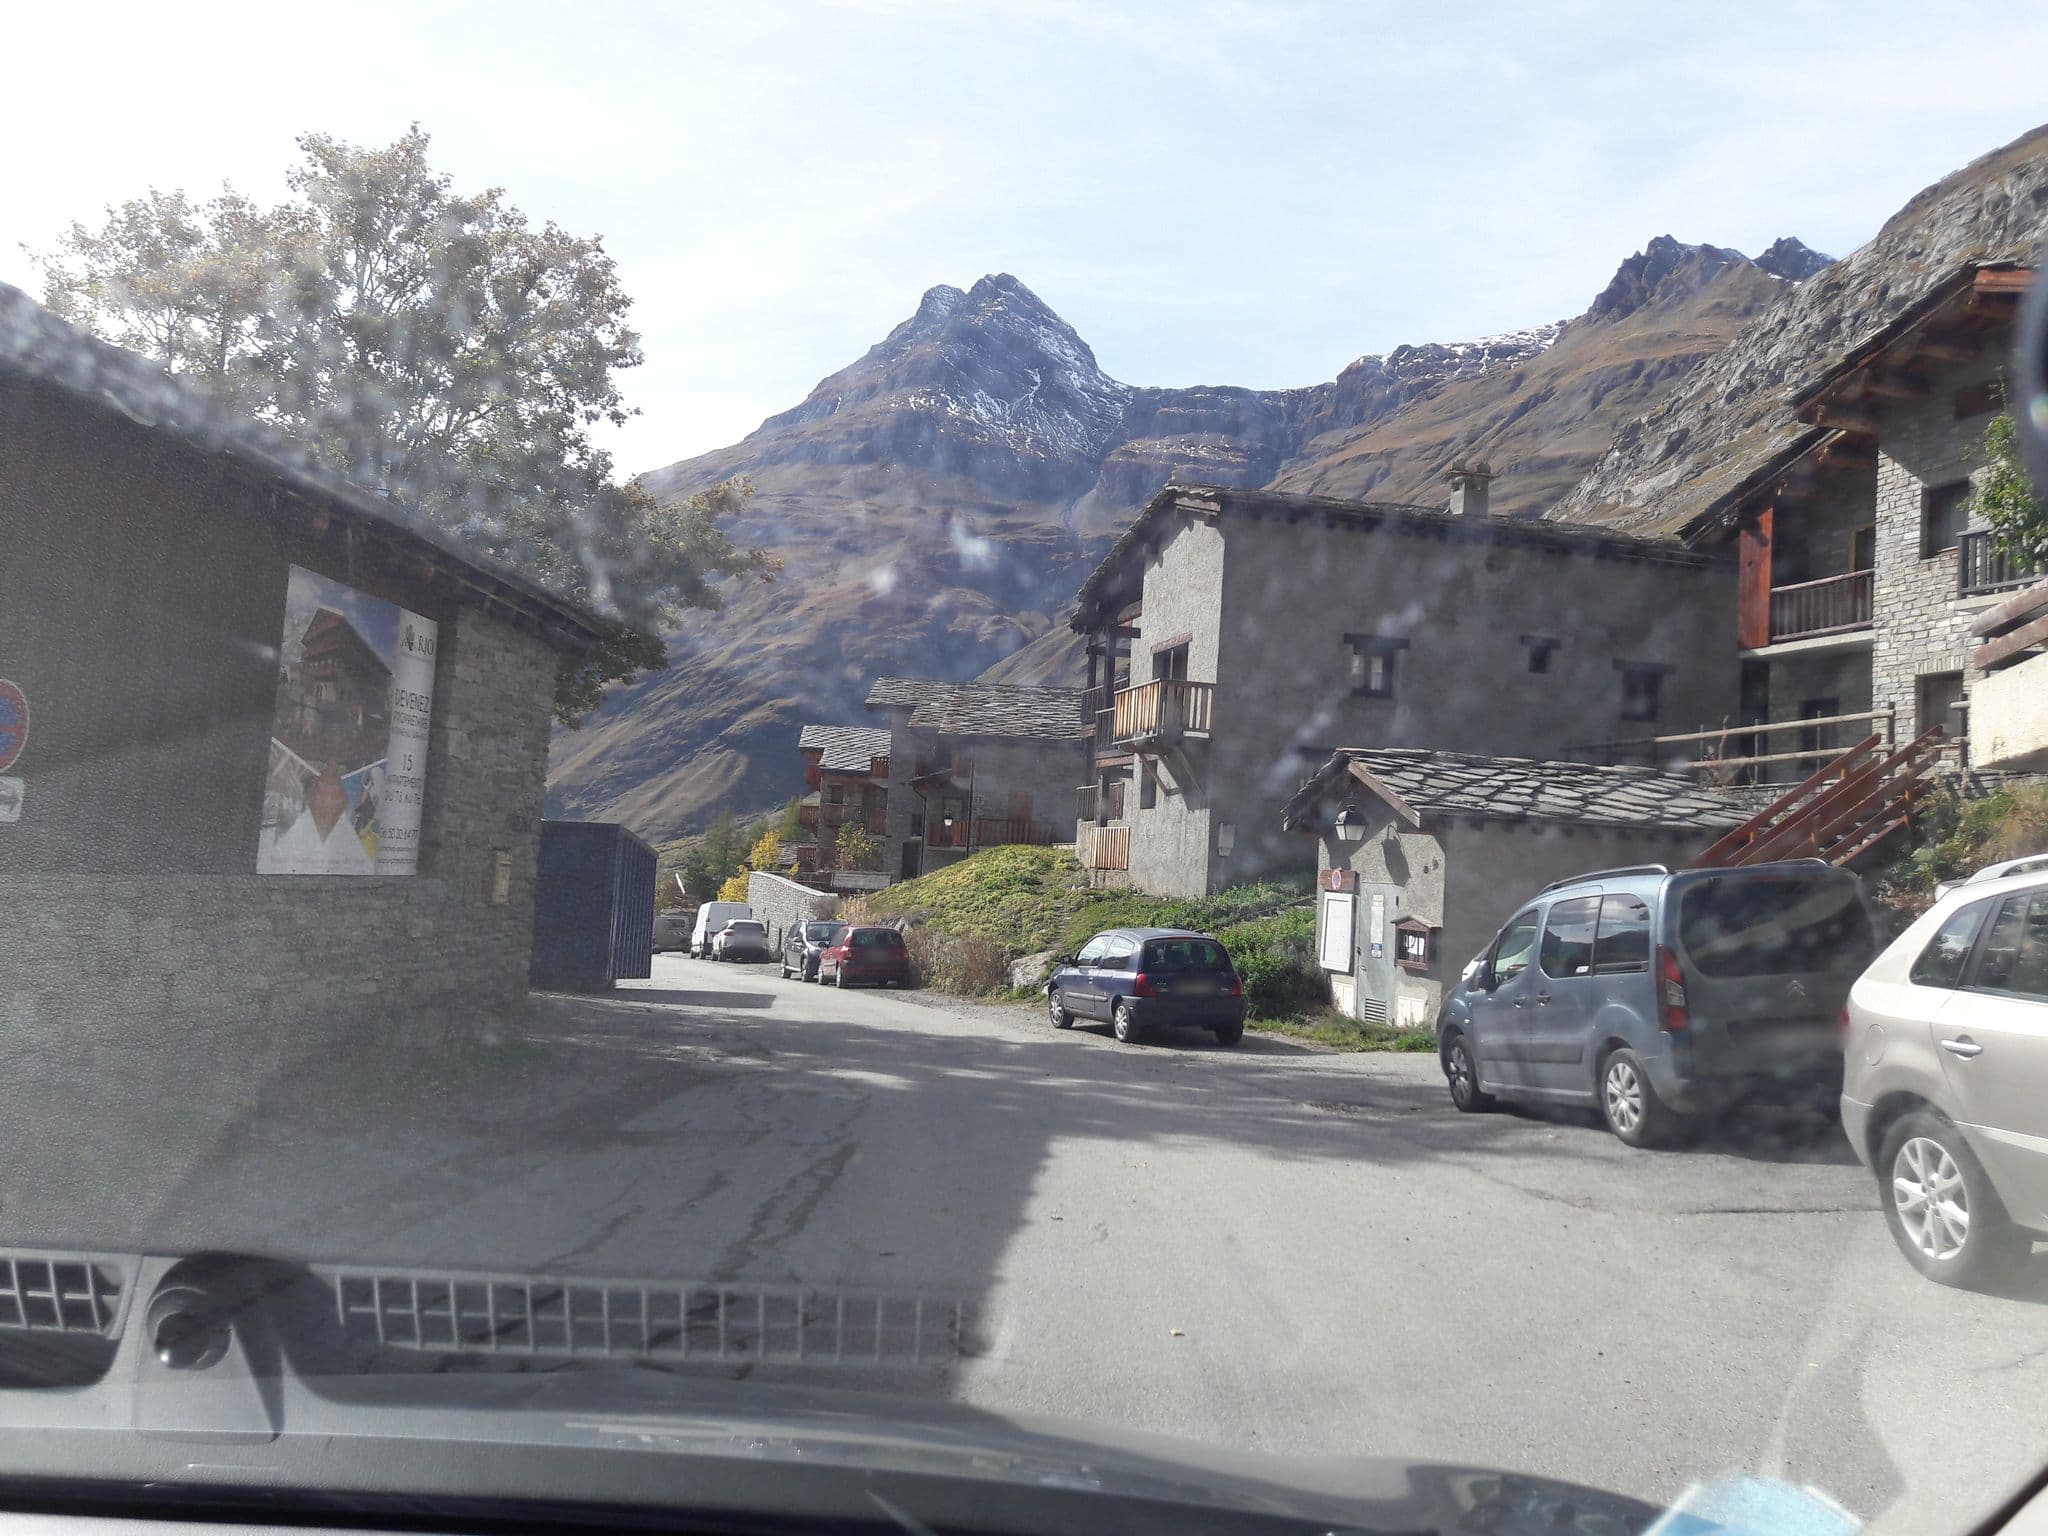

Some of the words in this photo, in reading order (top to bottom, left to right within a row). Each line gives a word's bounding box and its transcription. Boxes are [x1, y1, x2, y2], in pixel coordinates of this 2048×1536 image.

[418, 635, 434, 655] RIO
[394, 687, 430, 713] DEVENEZ
[403, 753, 413, 772] 15
